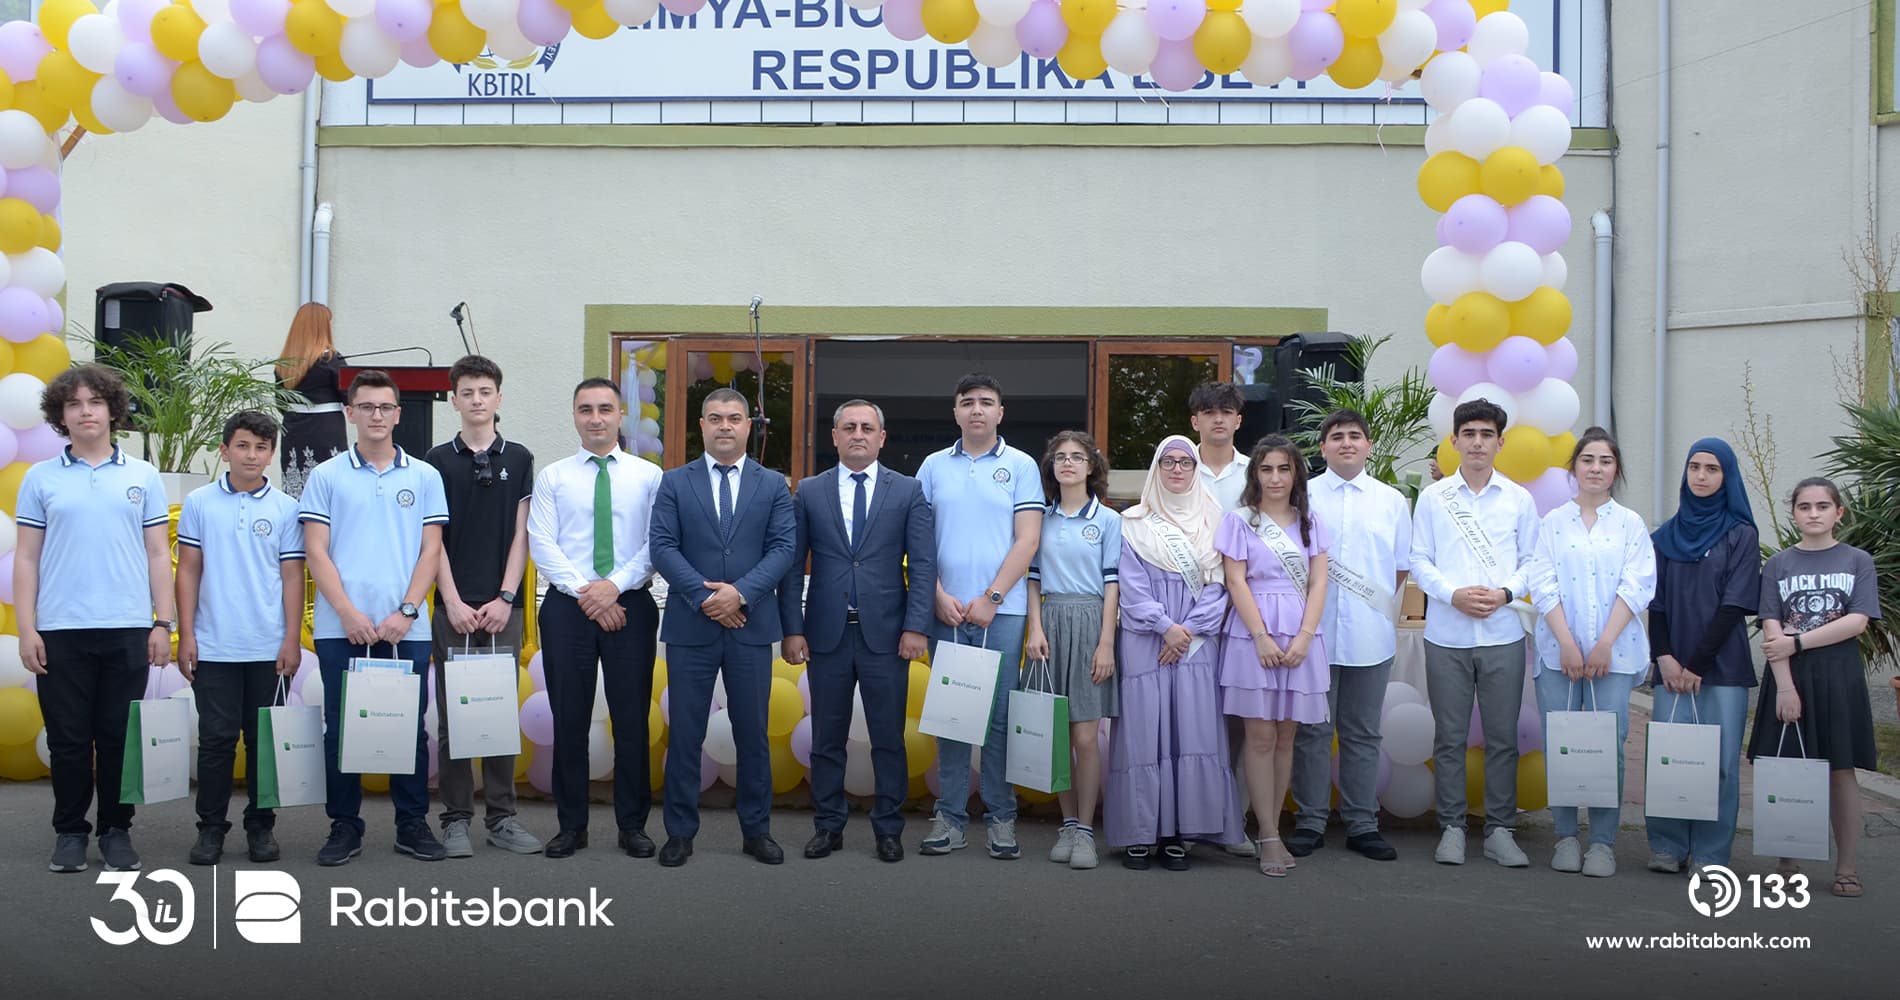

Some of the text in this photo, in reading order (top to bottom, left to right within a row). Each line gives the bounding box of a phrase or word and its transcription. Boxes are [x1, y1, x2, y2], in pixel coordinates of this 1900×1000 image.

[468, 73, 536, 96] KBTRL
[1778, 573, 1855, 602] BLACK MOON
